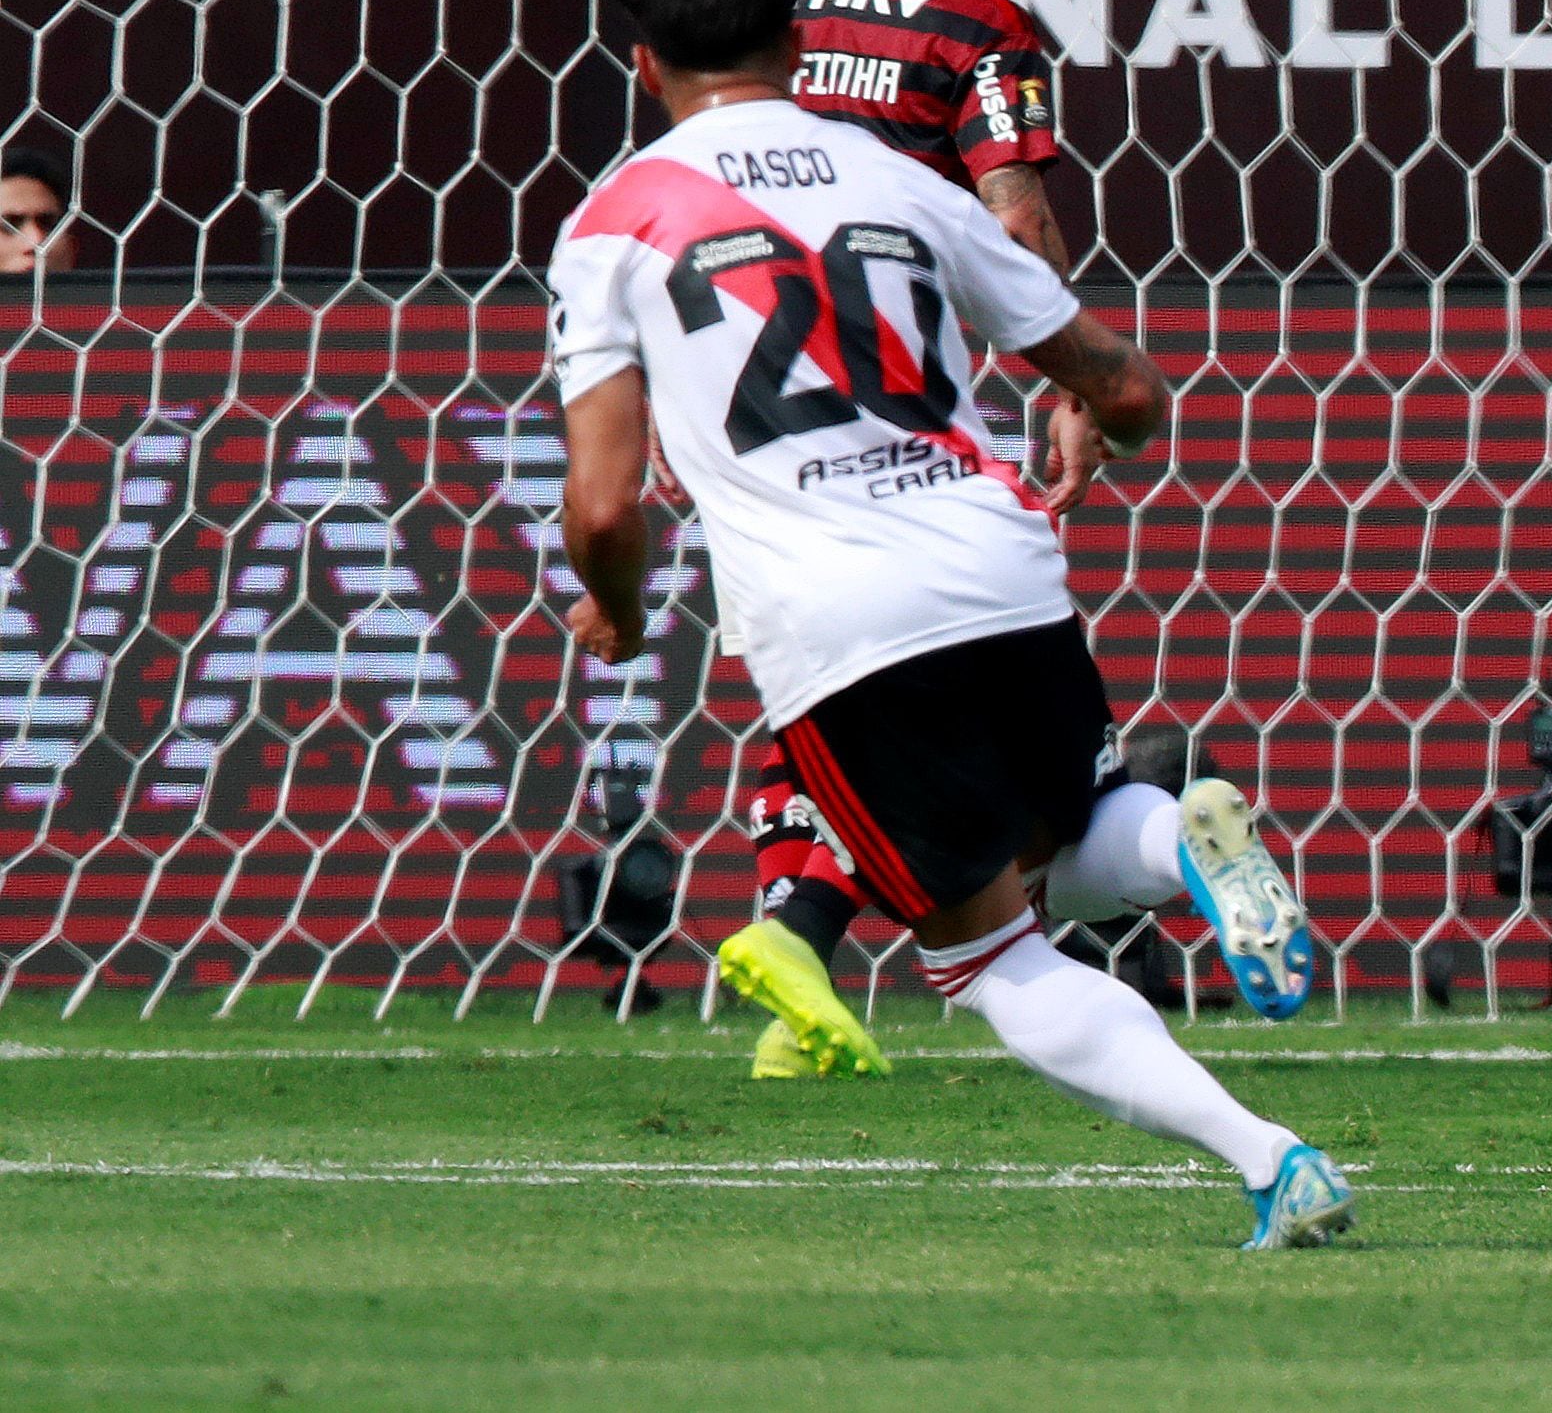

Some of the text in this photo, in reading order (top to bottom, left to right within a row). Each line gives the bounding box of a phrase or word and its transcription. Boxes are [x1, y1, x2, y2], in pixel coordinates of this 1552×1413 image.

[974, 52, 1019, 144] buser
[716, 148, 836, 188] CASCO
[666, 221, 959, 456] 20
[868, 453, 982, 499] CARD
